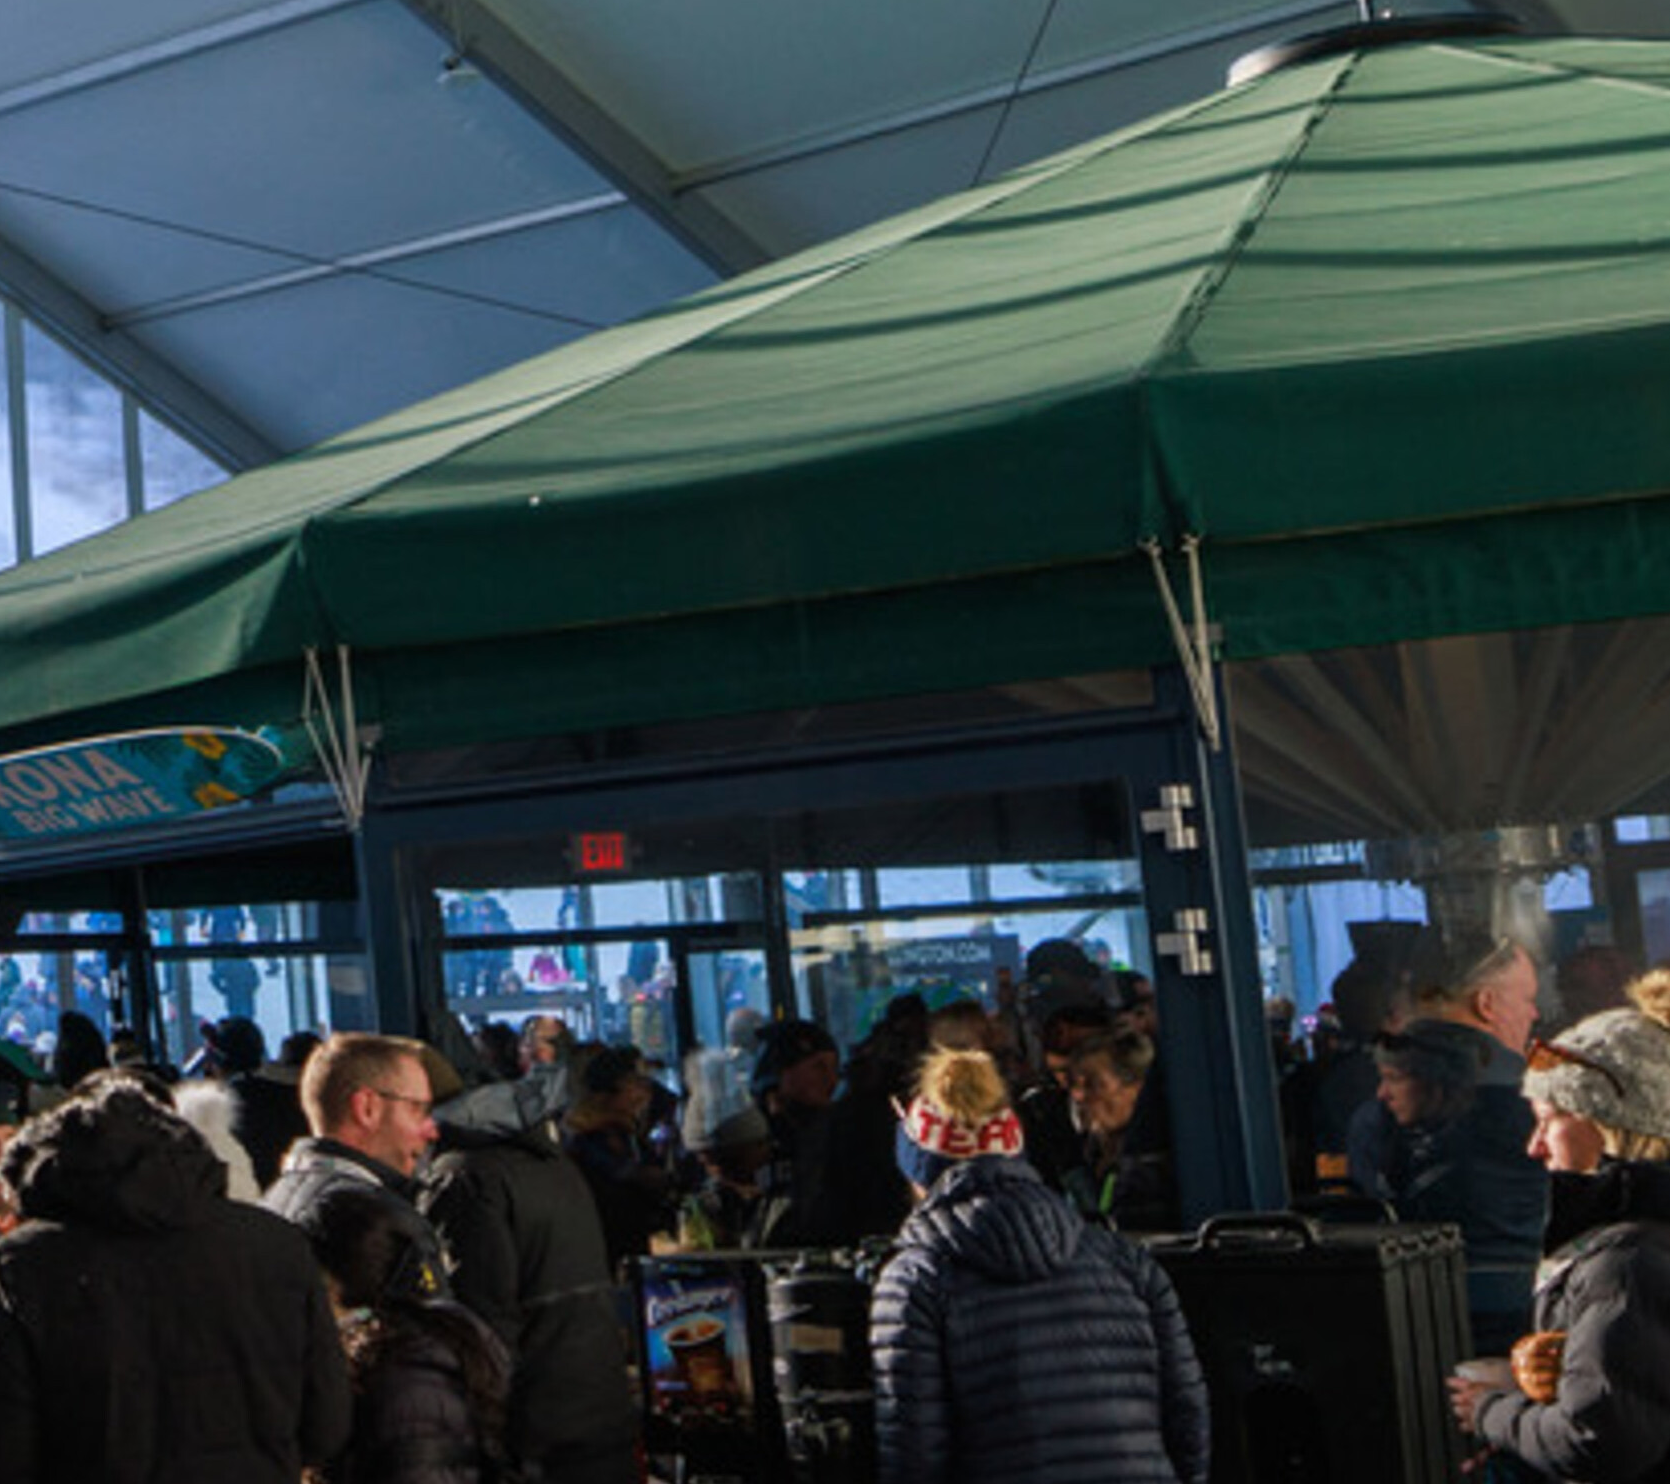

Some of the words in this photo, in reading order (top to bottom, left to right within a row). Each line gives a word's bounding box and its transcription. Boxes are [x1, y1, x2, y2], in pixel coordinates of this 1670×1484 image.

[11, 802, 78, 833] BIG
[69, 786, 176, 824] WAVE
[582, 832, 625, 870] EXIT
